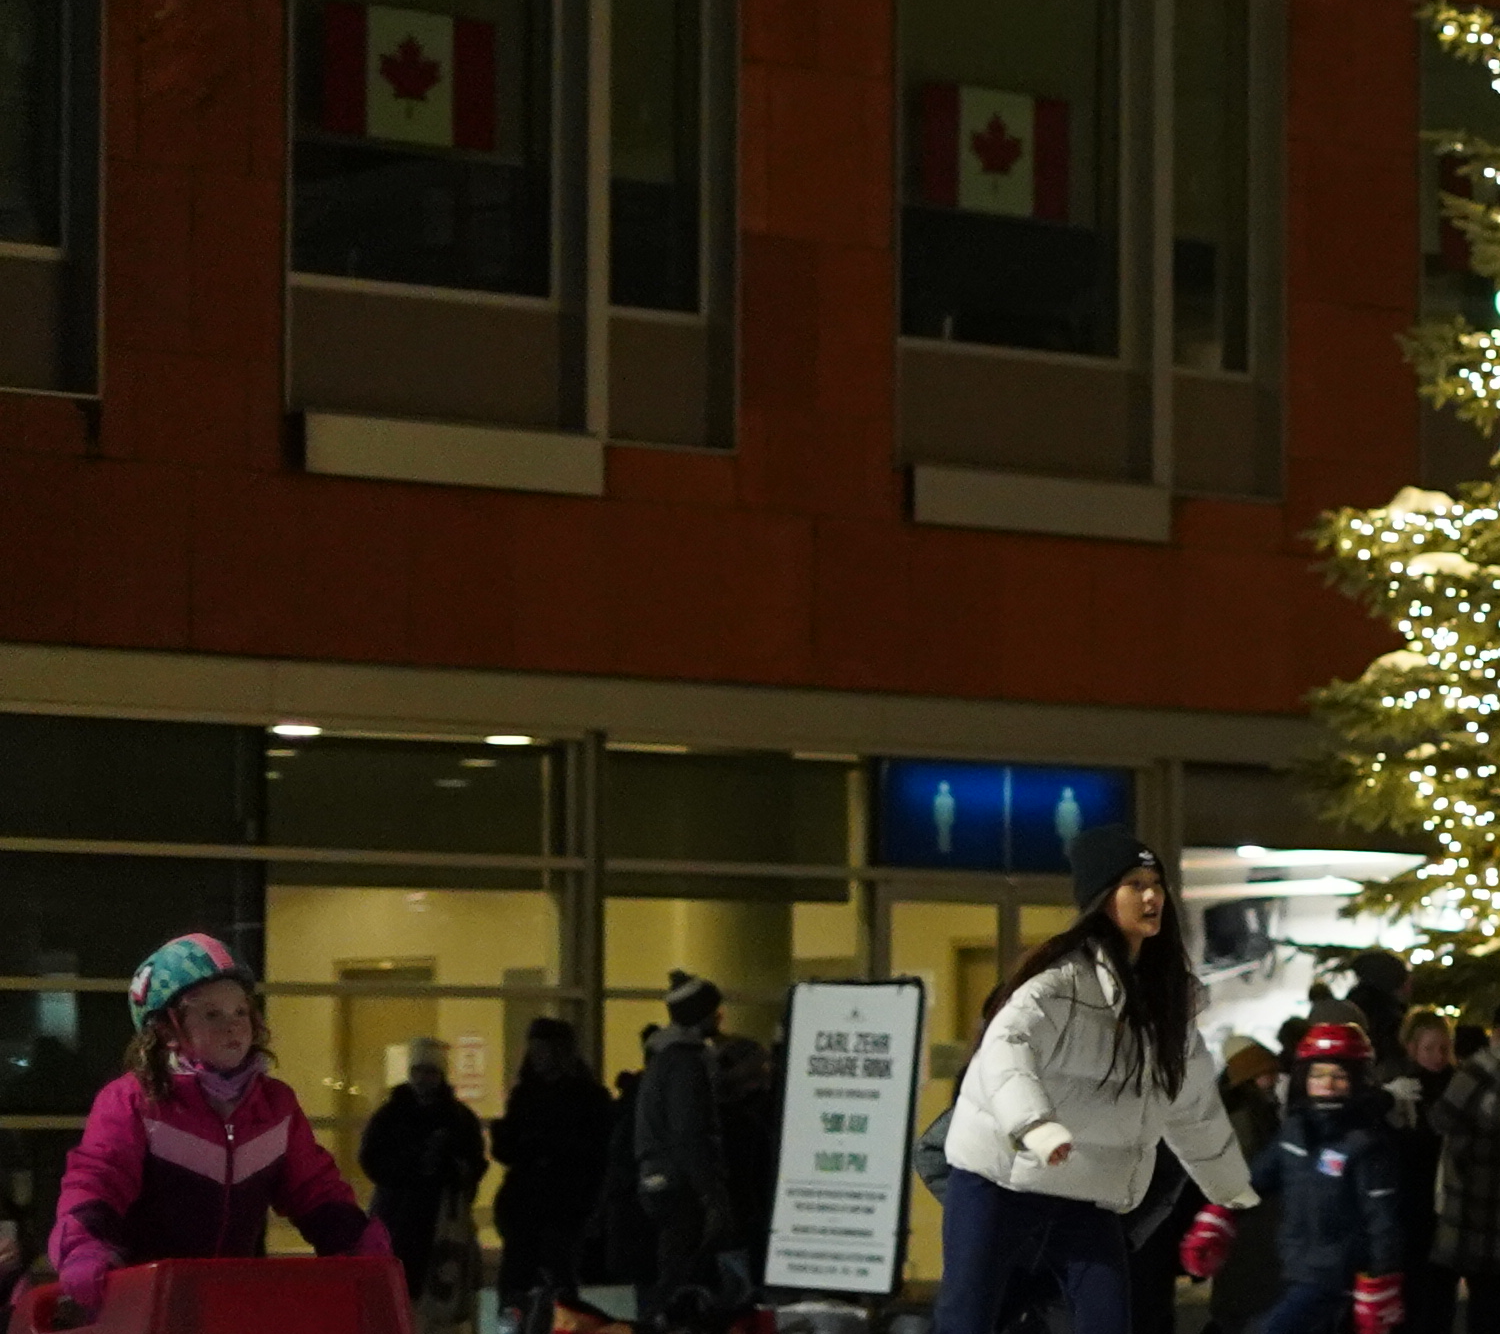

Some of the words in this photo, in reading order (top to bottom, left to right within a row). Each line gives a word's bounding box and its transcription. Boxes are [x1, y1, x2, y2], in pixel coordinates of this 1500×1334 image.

[815, 1031, 850, 1054] CARL
[852, 1032, 891, 1055] ZEHR
[807, 1055, 858, 1078] SQUARE
[862, 1057, 893, 1079] RINK
